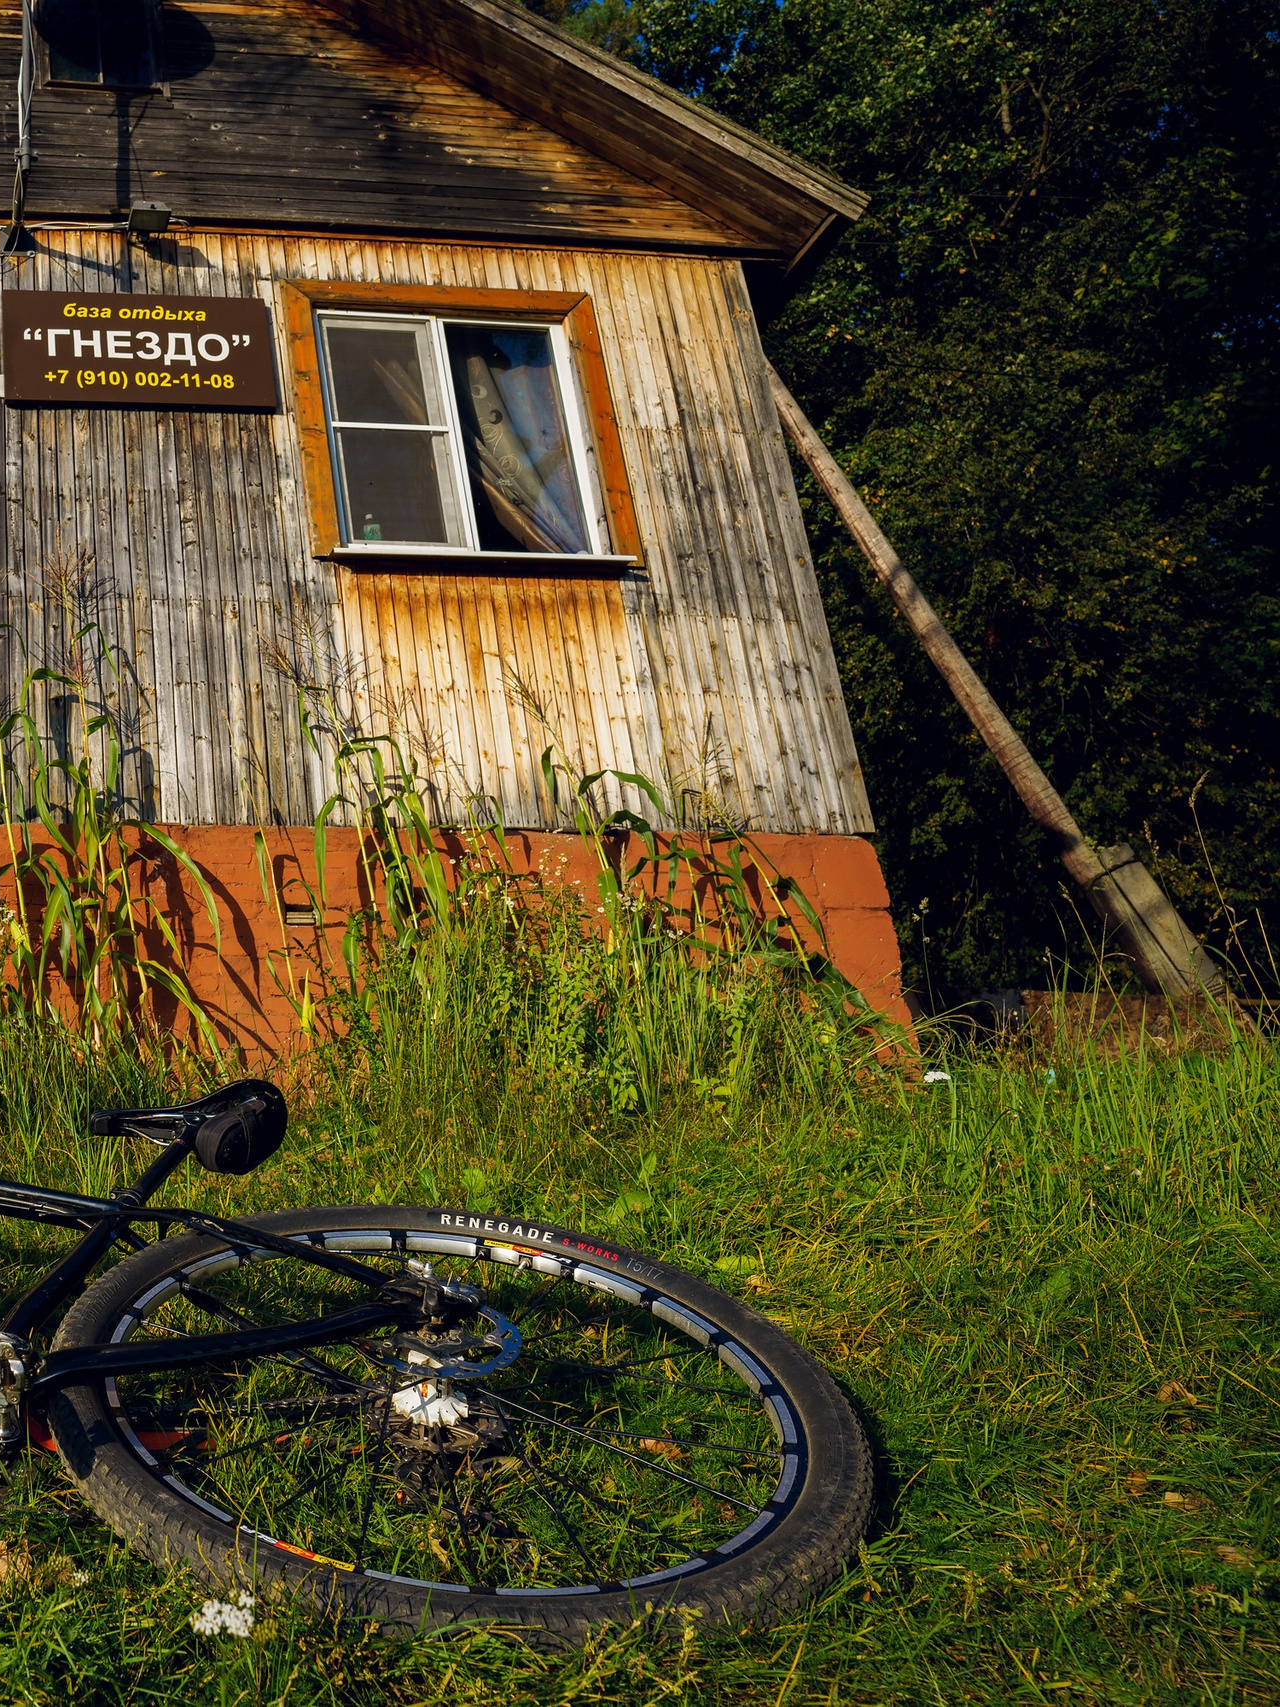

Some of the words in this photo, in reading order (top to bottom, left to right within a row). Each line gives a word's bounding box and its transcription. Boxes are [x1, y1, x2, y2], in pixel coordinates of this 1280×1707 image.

[63, 303, 112, 318] база
[118, 306, 207, 321] отдыха
[44, 370, 69, 385] +7
[76, 370, 129, 389] (910)
[135, 372, 235, 389] 002-11-08
[440, 1214, 555, 1243] RENEGADE
[562, 1237, 620, 1262] S-WORKS
[625, 1257, 665, 1280] T5/T7
